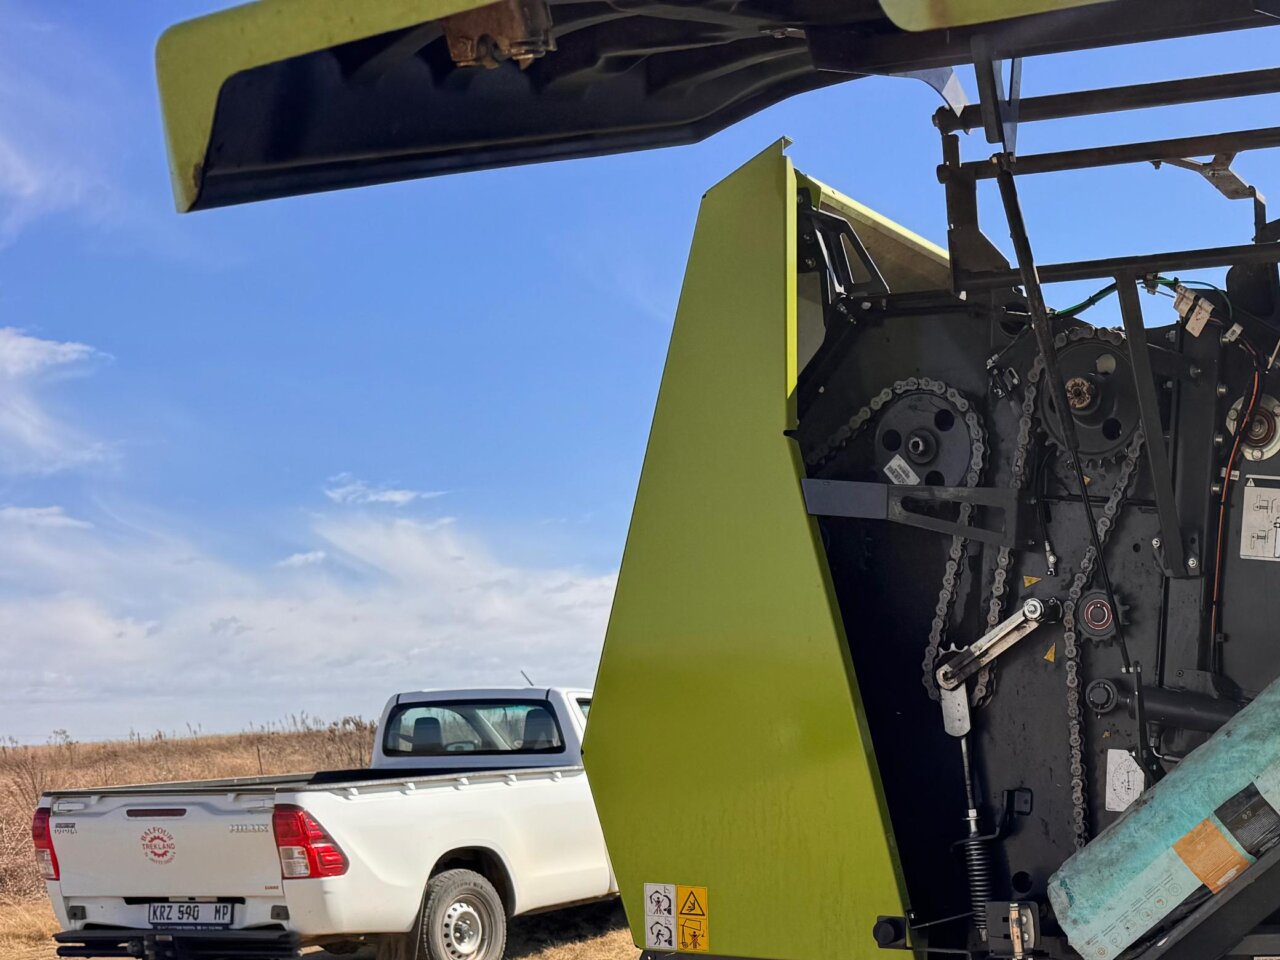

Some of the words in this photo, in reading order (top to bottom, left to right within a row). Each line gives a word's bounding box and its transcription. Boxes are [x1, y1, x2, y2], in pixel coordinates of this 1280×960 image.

[141, 826, 174, 842] BALFOUR
[152, 904, 173, 921] KRZ
[177, 904, 200, 921] 590
[214, 904, 229, 921] MP
